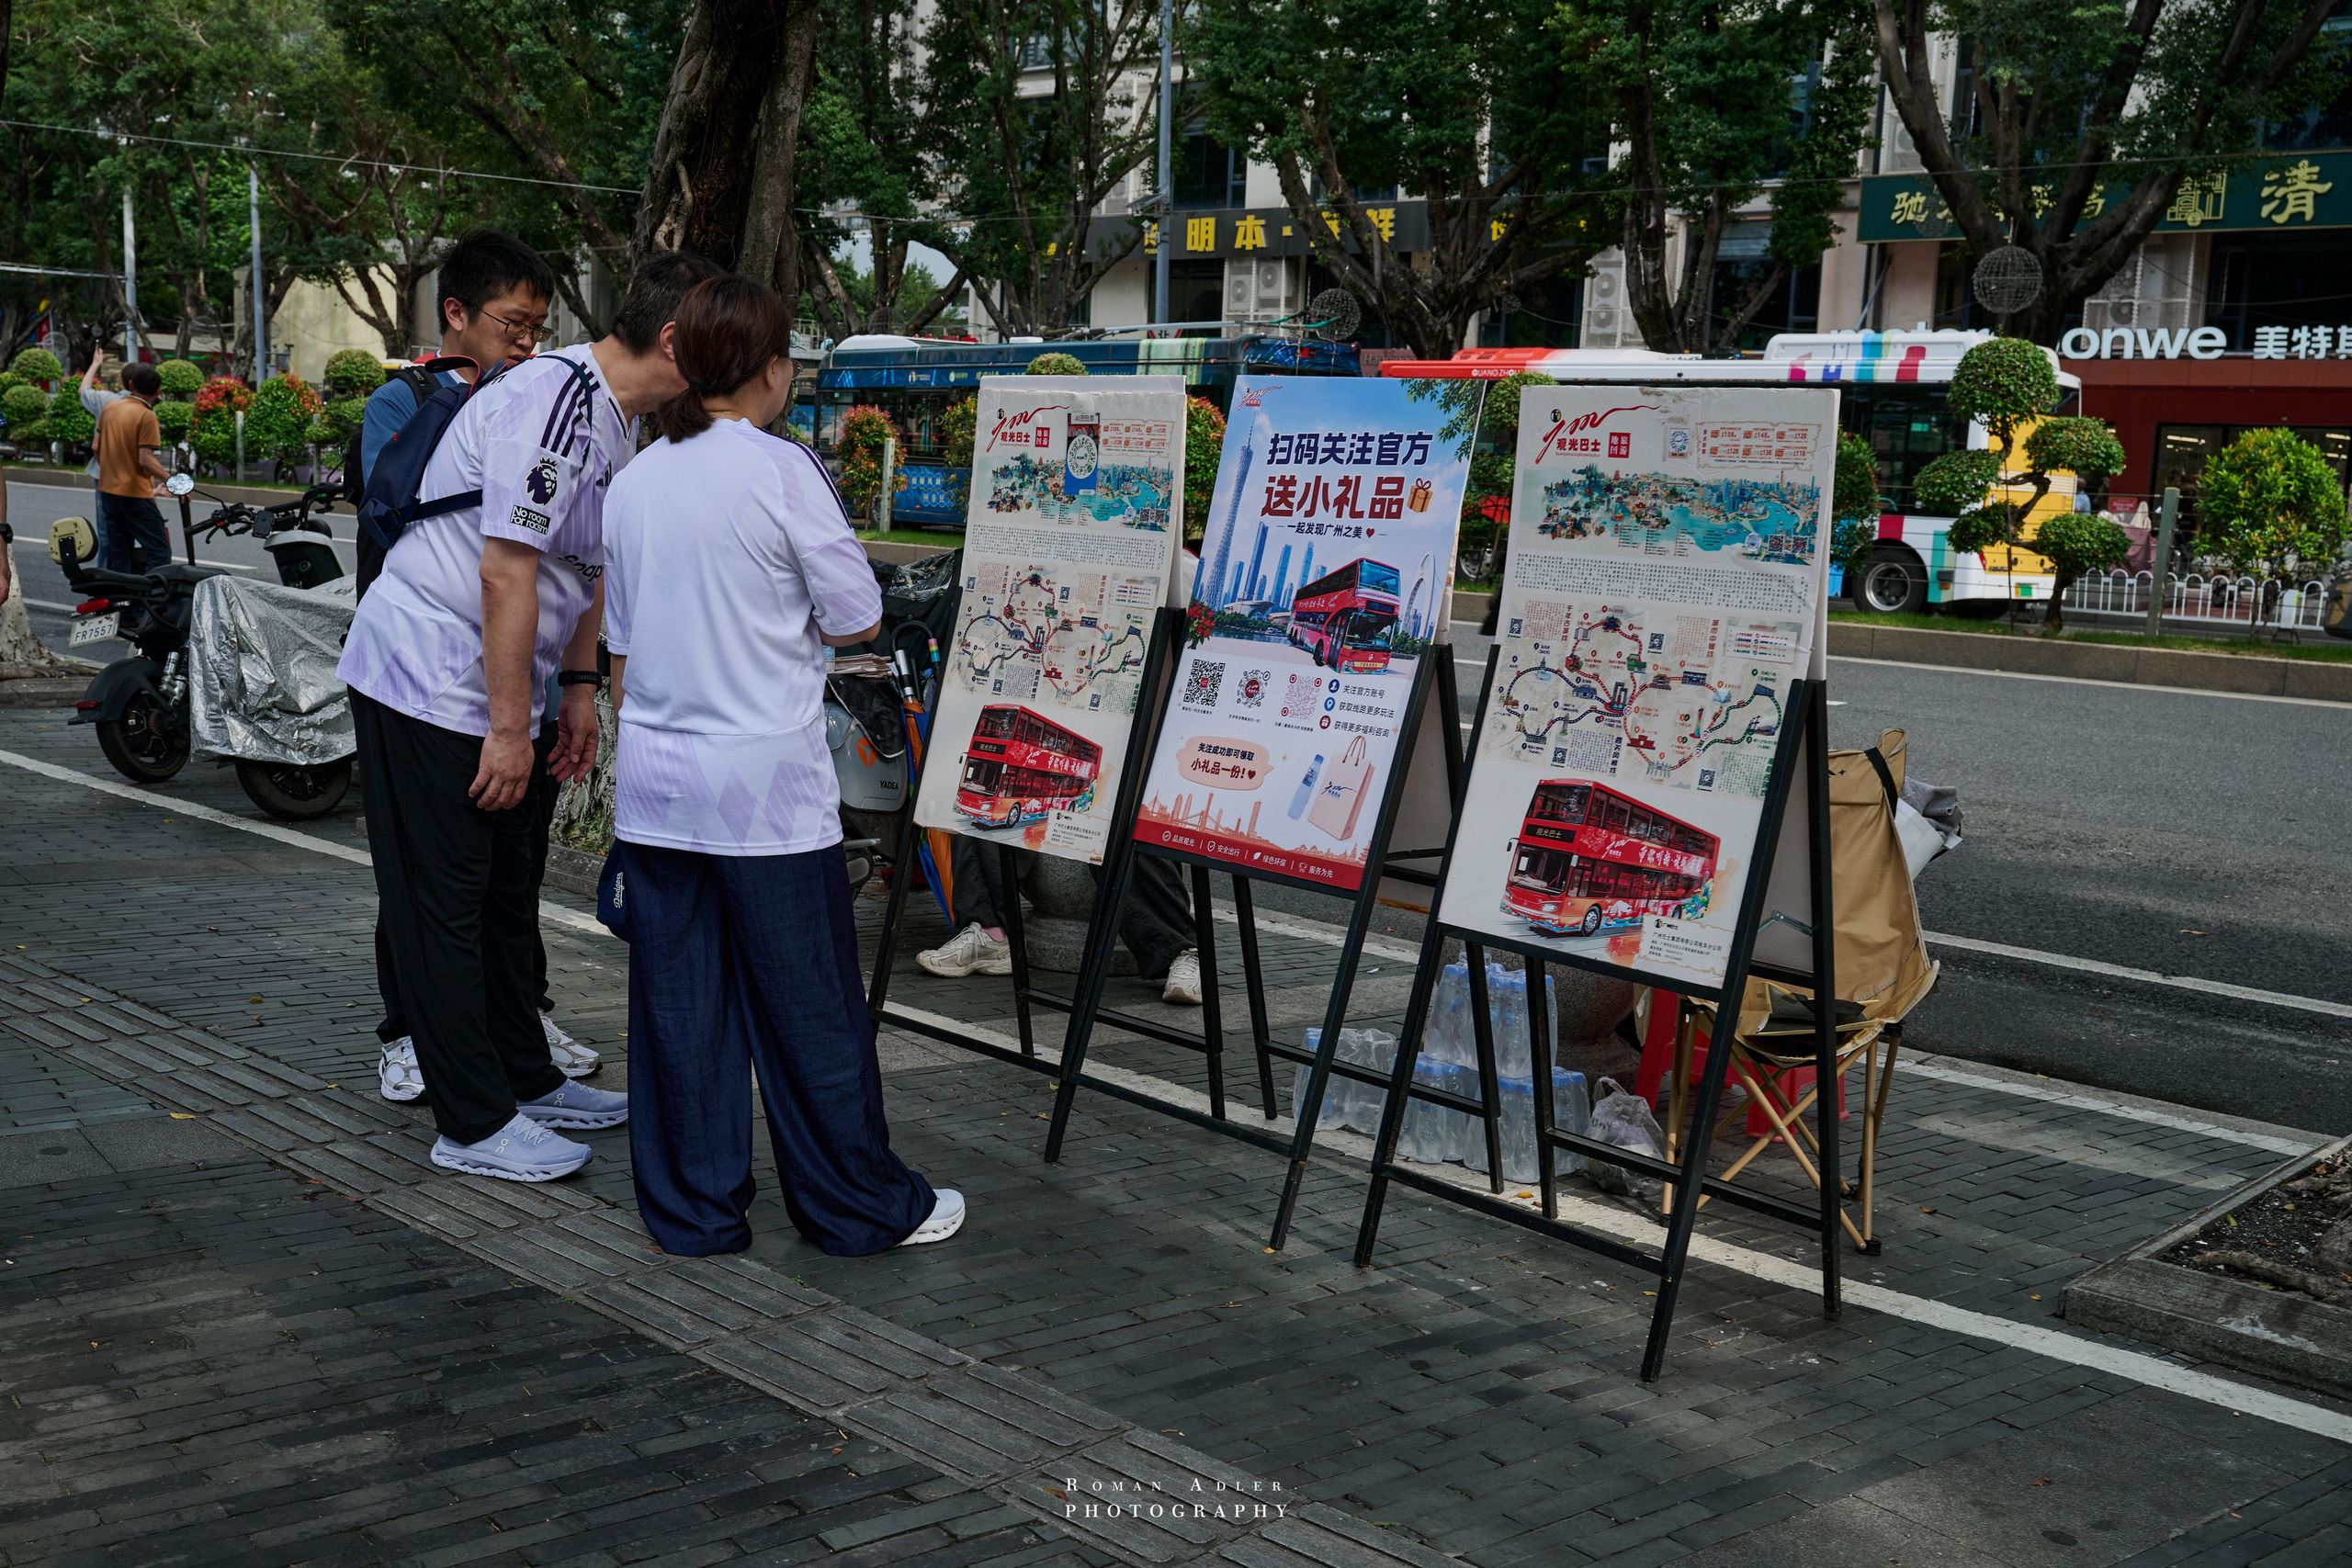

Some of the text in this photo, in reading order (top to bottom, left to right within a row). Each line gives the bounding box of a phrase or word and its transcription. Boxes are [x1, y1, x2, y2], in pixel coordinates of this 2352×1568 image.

[2261, 160, 2333, 223] 清
[1001, 432, 1030, 443] 观光巴士
[1556, 438, 1600, 452] 观光巴士
[1267, 432, 1434, 466] 扫码关注官方
[1261, 475, 1406, 519] 送小礼品
[513, 506, 547, 525] No room
[1287, 522, 1363, 538] 一起发现广州之美
[74, 625, 113, 642] FR7557
[1342, 684, 1385, 698] 关注官方账号
[1339, 702, 1395, 718] 获取线路更多玩法
[1334, 720, 1390, 738] 获得更多福利咨询
[1198, 742, 1254, 761] 关注成功即可领取
[880, 780, 899, 790] YADEA
[1171, 835, 1194, 847] 品质观光
[1535, 828, 1562, 839] 观光巴士
[1217, 844, 1240, 856] 安全出行
[1261, 855, 1286, 867] 绿色环保
[1308, 866, 1333, 878] 服务为先
